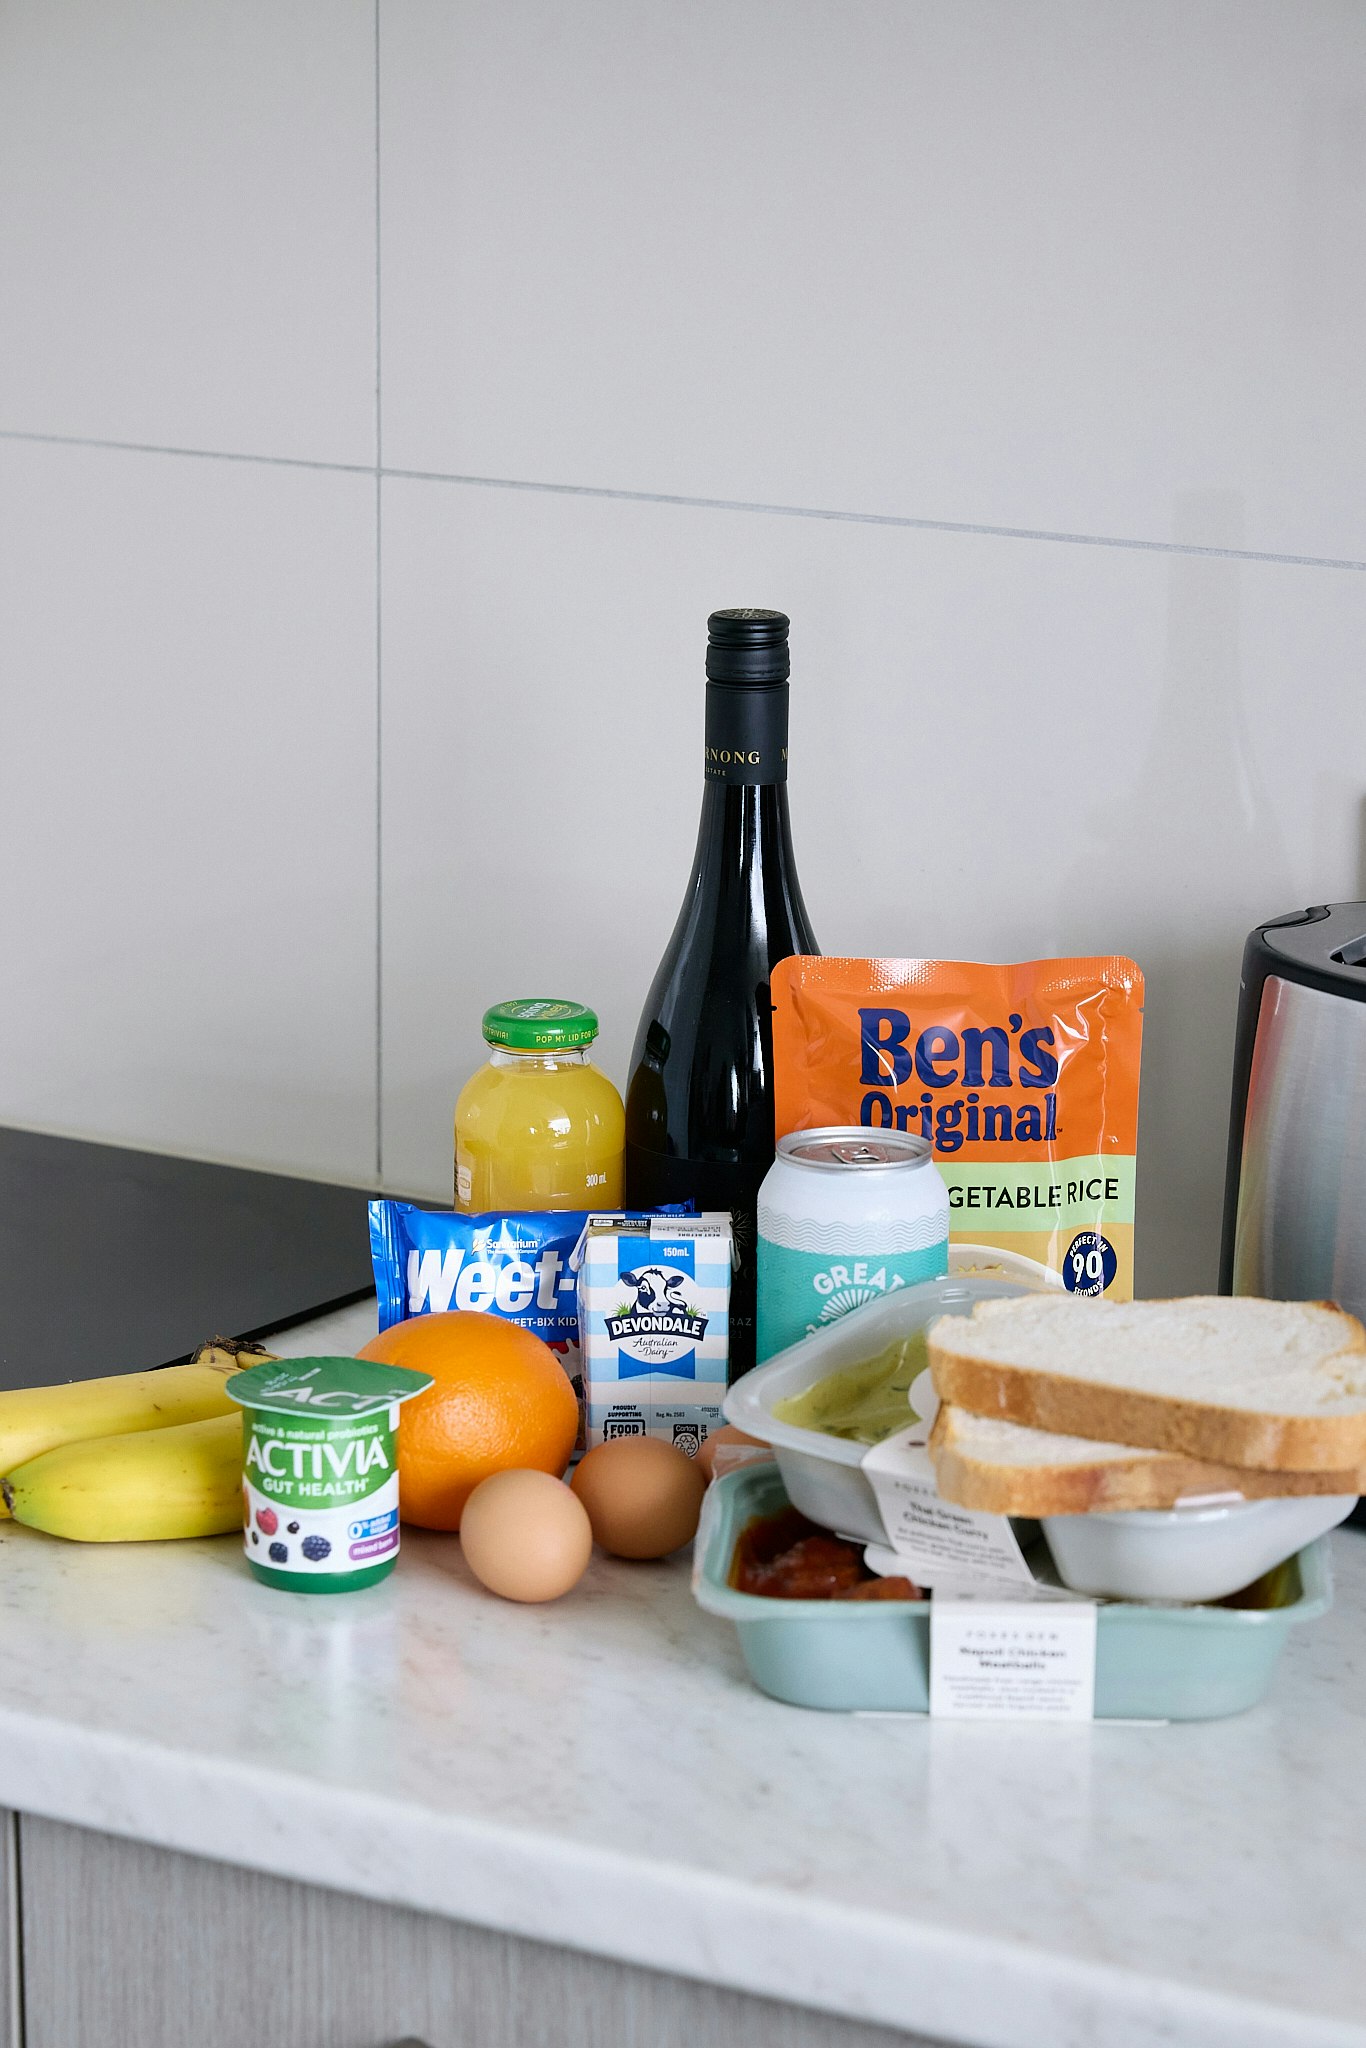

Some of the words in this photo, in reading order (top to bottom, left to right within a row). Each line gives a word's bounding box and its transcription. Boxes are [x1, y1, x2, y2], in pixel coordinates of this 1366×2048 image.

[536, 1035, 552, 1043] POP
[555, 1035, 566, 1043] MY
[568, 1033, 578, 1042] LID
[581, 1031, 591, 1039] FOR
[858, 1008, 1059, 1089] Ben's
[860, 1091, 1057, 1153] Original
[585, 1174, 598, 1188] 300
[1067, 1178, 1119, 1205] RICE
[663, 1247, 689, 1257] 150mL
[1070, 1235, 1097, 1257] PERFECT
[1072, 1250, 1103, 1283] 90
[813, 1262, 906, 1295] GREAT
[1073, 1280, 1104, 1297] SECONDS
[611, 1317, 702, 1336] DEVONDALE
[632, 1337, 678, 1348] Australian
[643, 1347, 668, 1359] Dairy
[610, 1424, 640, 1434] FOOD
[246, 1435, 389, 1480] ACTIVIA
[262, 1477, 294, 1495] GUT
[298, 1478, 369, 1497] HEALTH
